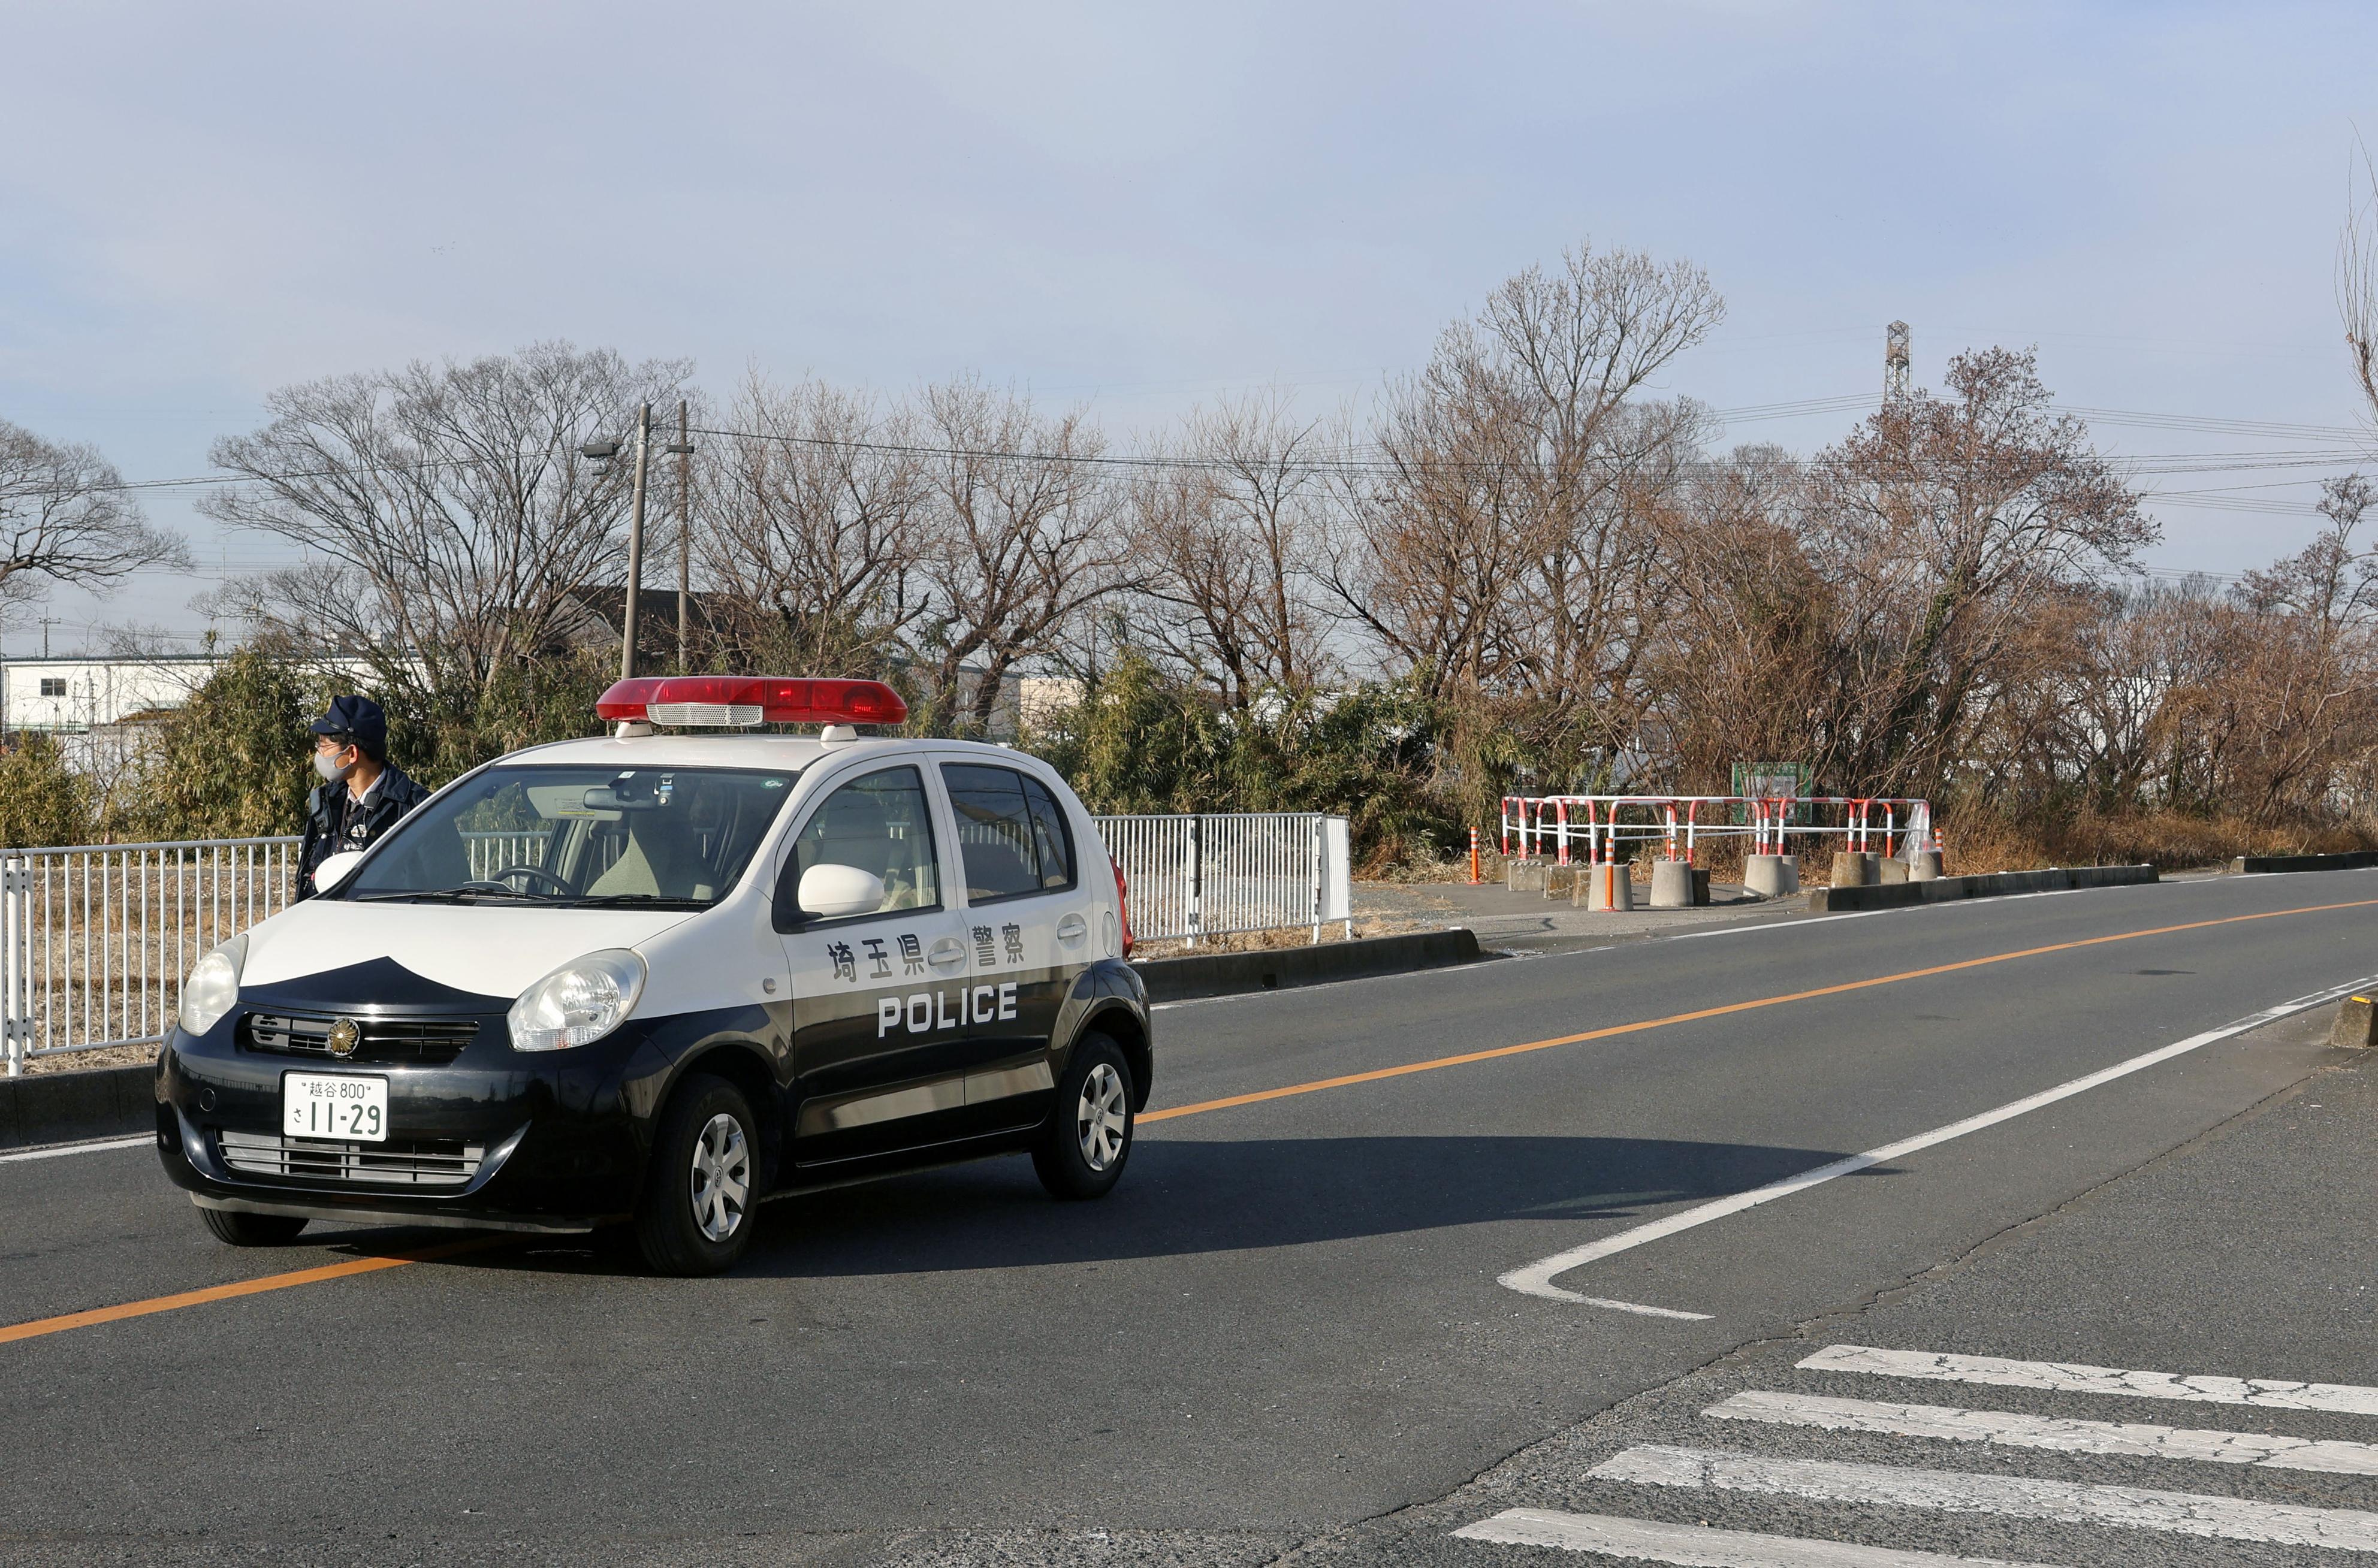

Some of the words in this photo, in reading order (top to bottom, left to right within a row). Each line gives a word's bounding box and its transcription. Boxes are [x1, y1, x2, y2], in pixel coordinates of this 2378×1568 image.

[827, 933, 925, 983] 埼玉県
[971, 922, 1025, 967] 警察
[877, 981, 1017, 1038] POLICE
[309, 1081, 337, 1098] 越谷
[340, 1083, 364, 1099] 800
[294, 1108, 301, 1123] さ
[311, 1101, 381, 1135] 11-29
